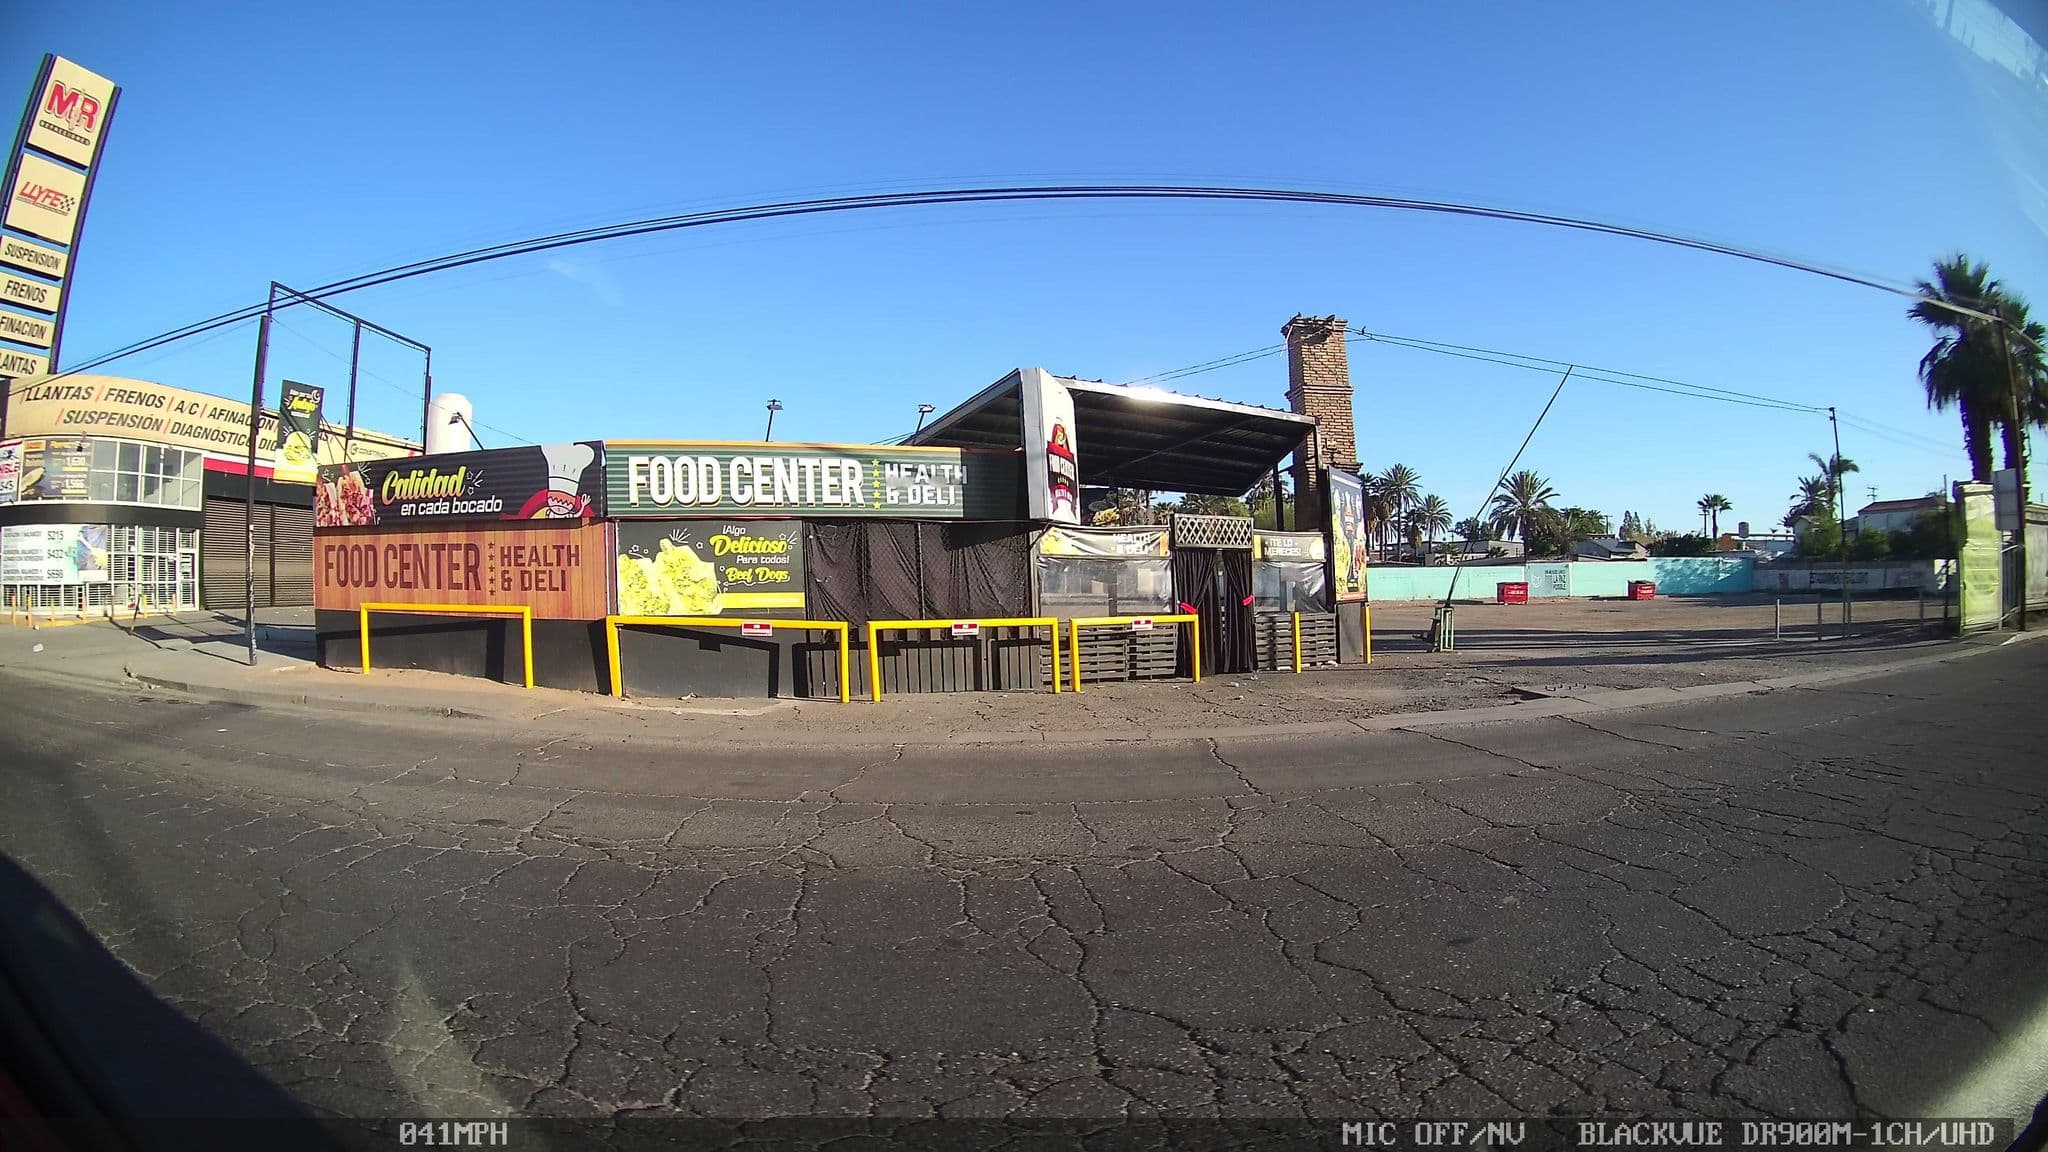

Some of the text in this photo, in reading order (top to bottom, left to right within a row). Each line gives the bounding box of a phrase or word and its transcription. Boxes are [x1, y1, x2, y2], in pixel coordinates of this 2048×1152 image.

[46, 81, 99, 132] MR
[4, 243, 61, 270] SUSPENSION
[3, 280, 47, 303] FRENOS
[25, 385, 95, 402] LLANTAS
[104, 387, 167, 409] FRENOS
[174, 400, 200, 416] A/C
[63, 409, 164, 432] SUSPENSIÓN
[381, 465, 467, 505] Calidad
[628, 455, 866, 508] FOOD CENTER
[884, 463, 968, 485] HEALTH
[400, 495, 503, 516] en cada bocado
[886, 485, 956, 505] & DELI
[500, 544, 580, 567] HEALTH
[709, 534, 788, 556] Delicioso
[324, 542, 481, 591] FOOD CENTER
[736, 555, 790, 564] Para todos!
[500, 569, 566, 591] & DELI
[725, 566, 790, 583] Beef Dogs
